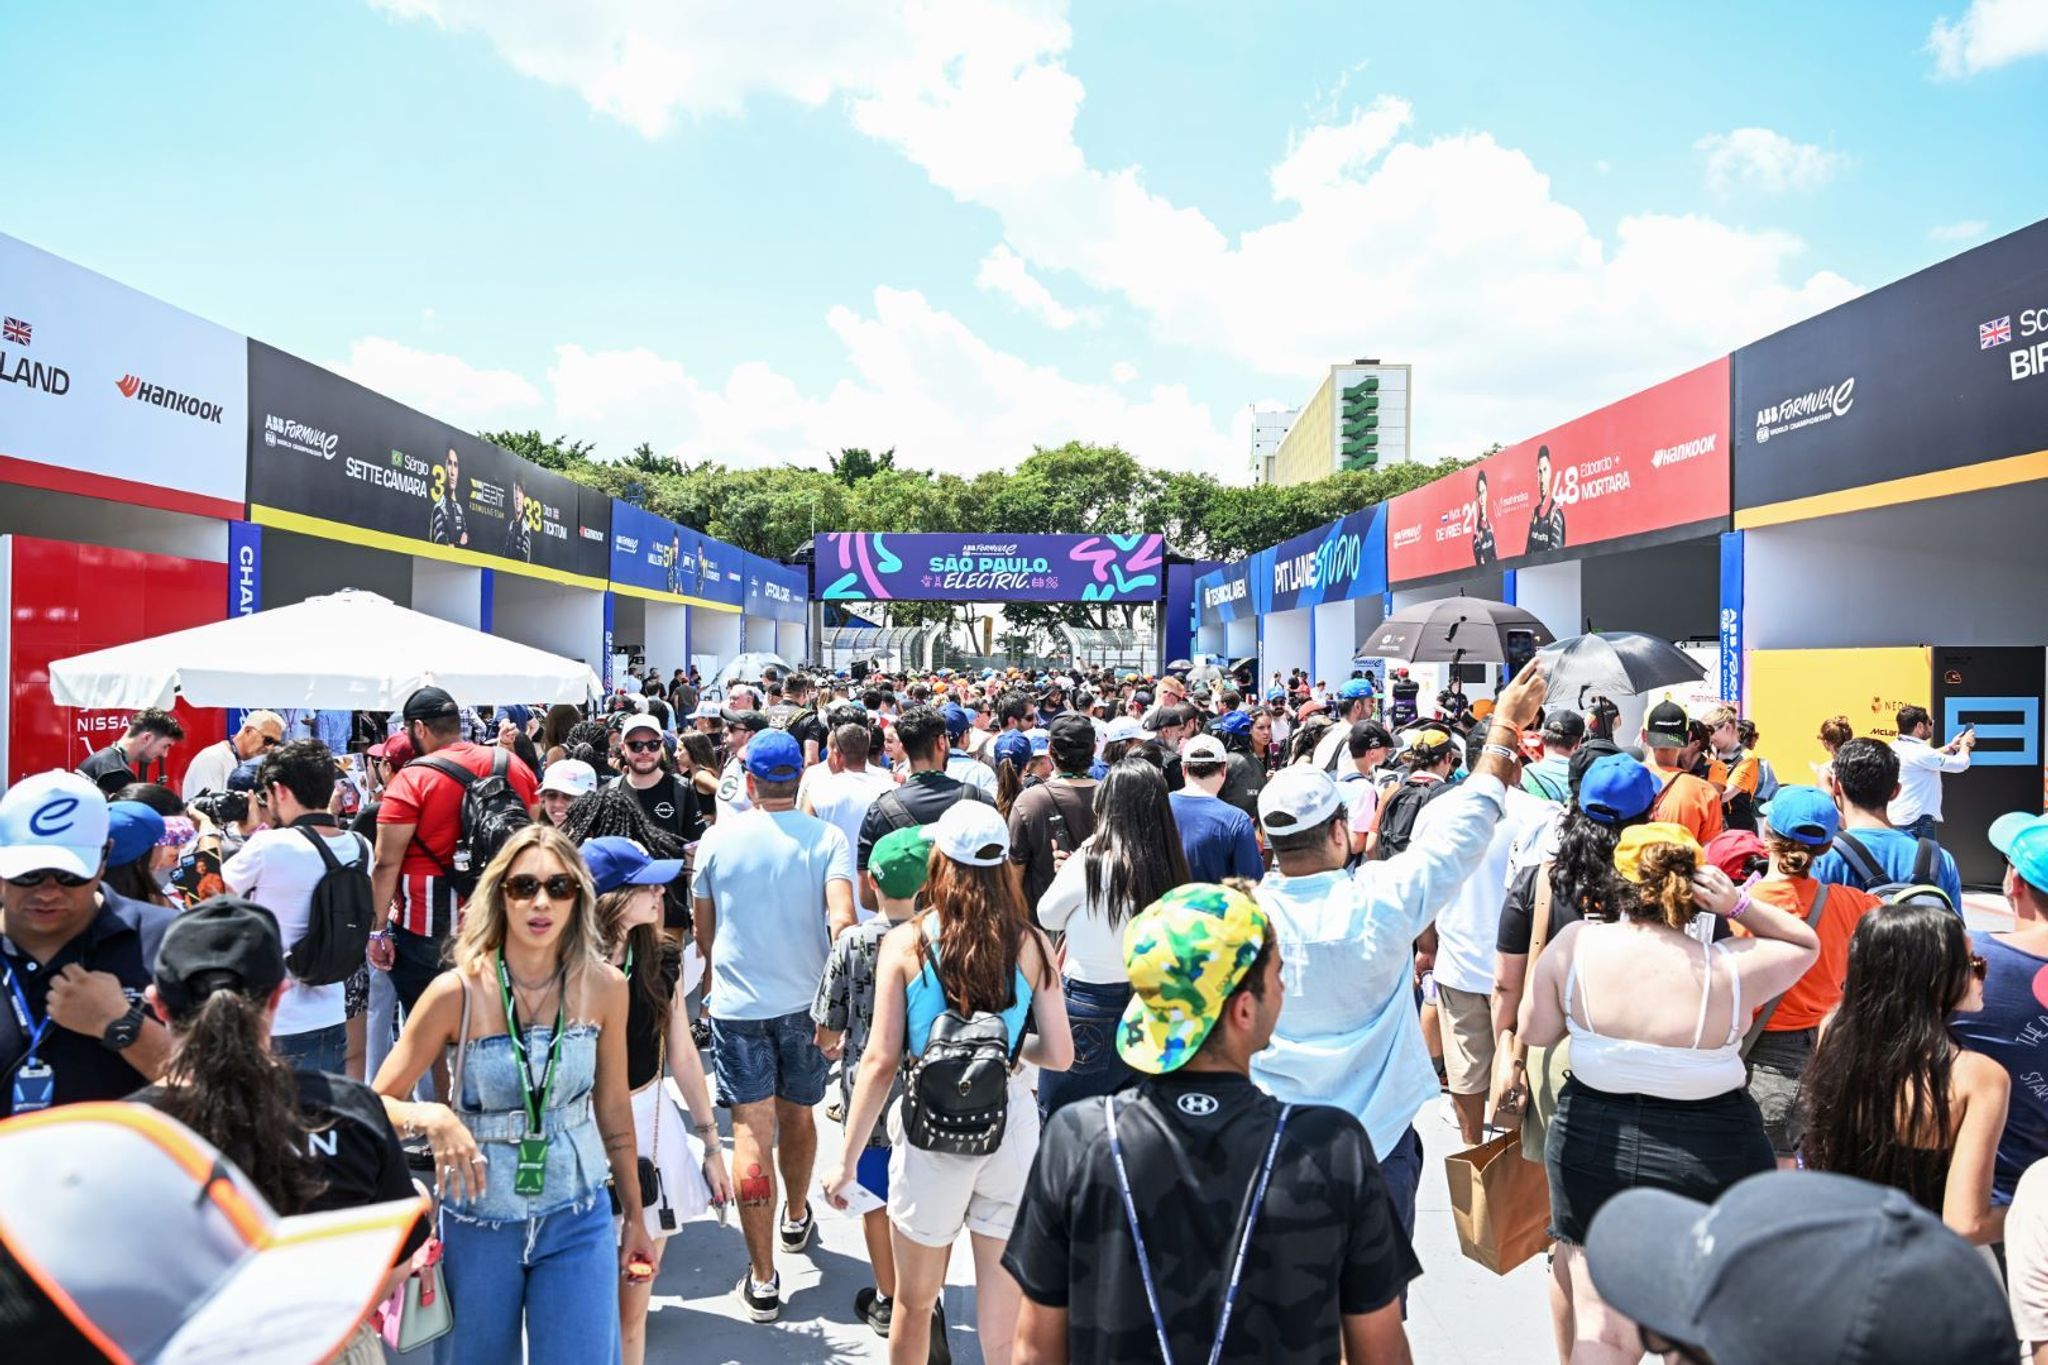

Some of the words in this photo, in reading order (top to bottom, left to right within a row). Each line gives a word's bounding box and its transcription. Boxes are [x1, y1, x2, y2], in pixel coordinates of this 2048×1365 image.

[1756, 406, 1778, 428] ABB
[1777, 385, 1834, 423] FORMULA
[1769, 425, 1789, 437] WORLD
[1789, 411, 1833, 431] CHAMPIONSHIP
[265, 413, 284, 434] ABB
[283, 419, 327, 449] FORMULA
[346, 455, 383, 486] SETTE
[430, 464, 447, 502] 3
[1552, 466, 1580, 508] 48
[1581, 470, 1632, 501] MORTARA
[523, 496, 542, 532] 33
[929, 554, 974, 573] SÃO
[978, 556, 1052, 574] PAULO.
[1275, 560, 1289, 595] PIT
[1289, 551, 1316, 592] LANE
[1312, 532, 1361, 592] STUDIO
[943, 571, 1030, 591] ELECTRIC.
[1885, 701, 1911, 711] NEO
